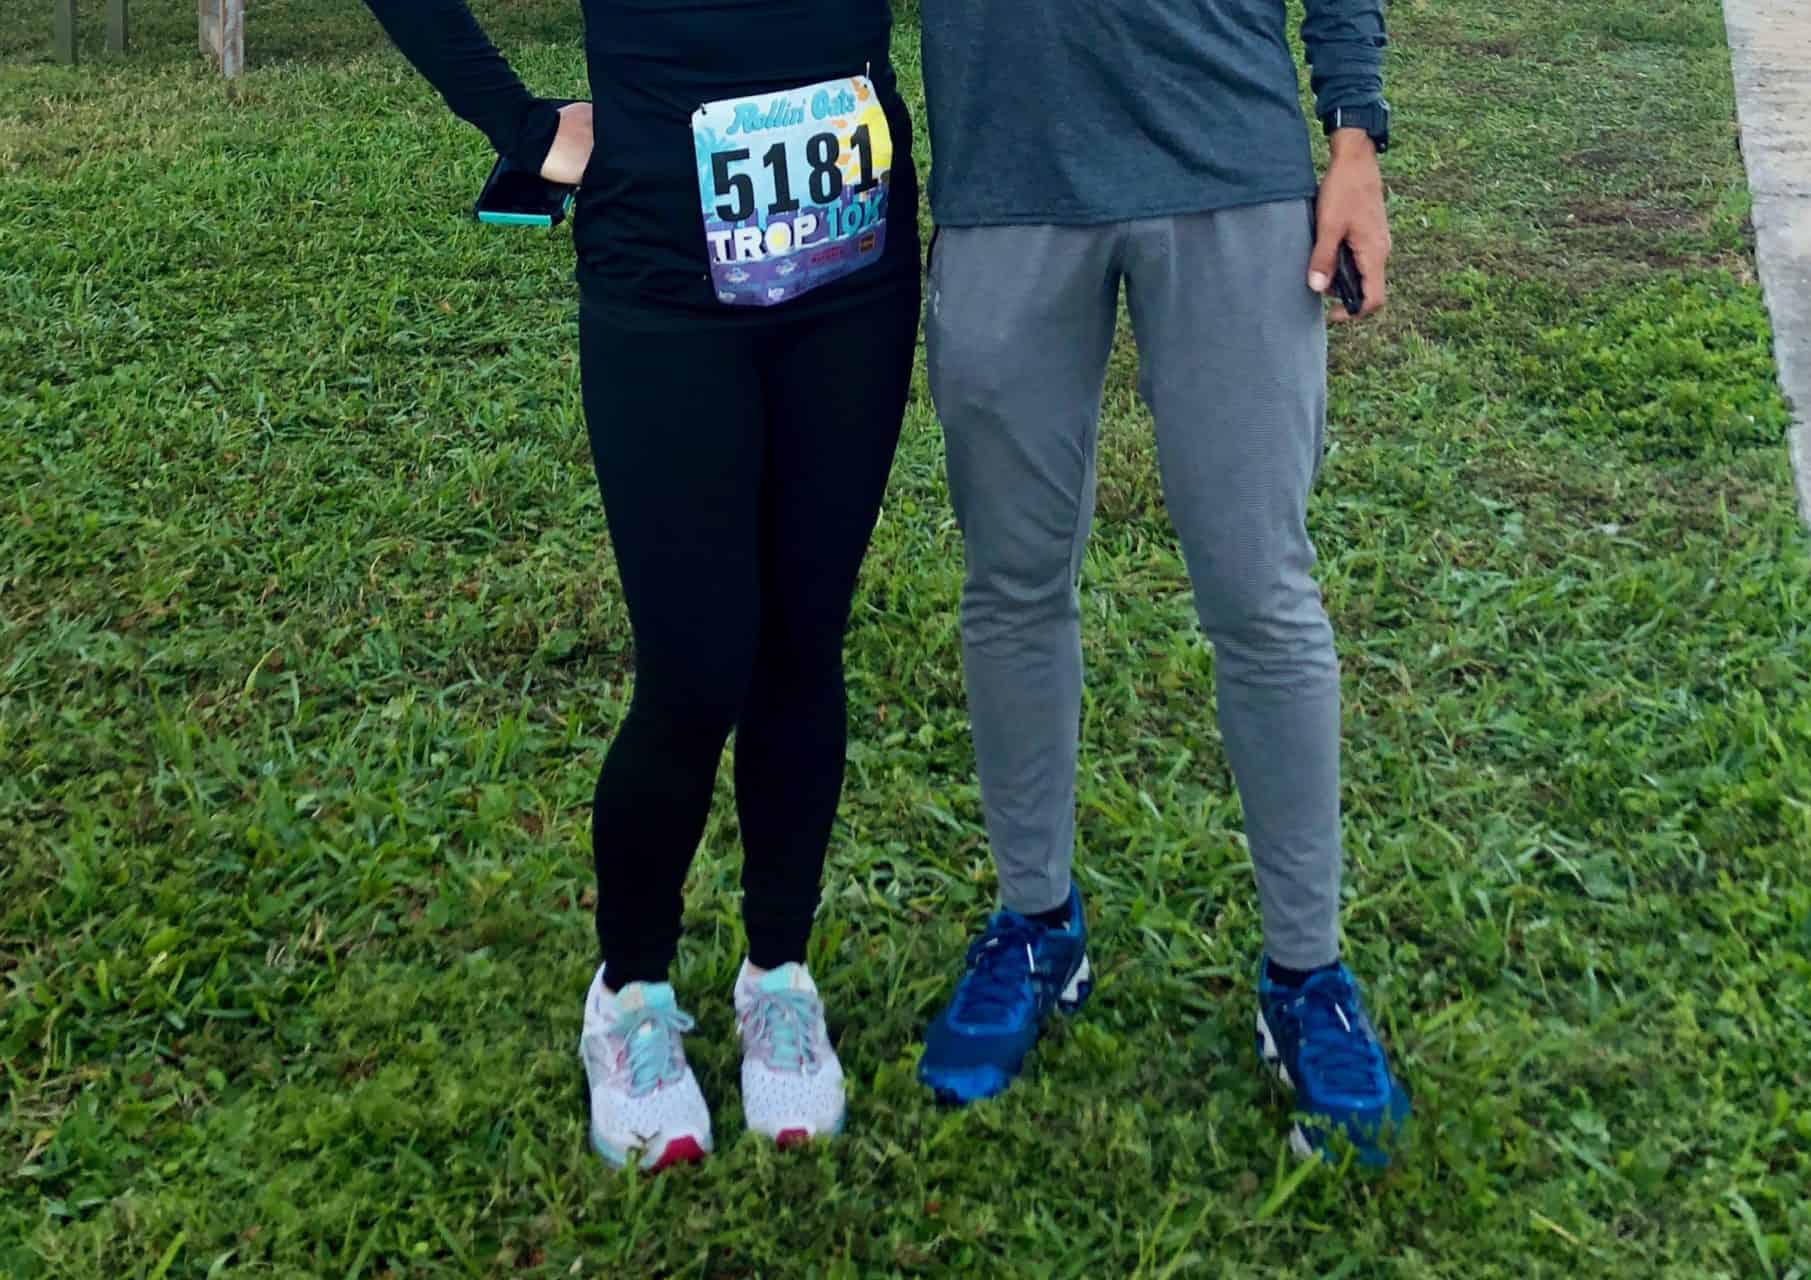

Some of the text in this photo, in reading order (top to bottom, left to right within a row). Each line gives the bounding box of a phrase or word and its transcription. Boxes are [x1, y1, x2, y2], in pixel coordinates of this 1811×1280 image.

[726, 88, 856, 136] Rollin' Oats
[711, 123, 879, 223] 5181
[706, 193, 885, 265] TROP 10K
